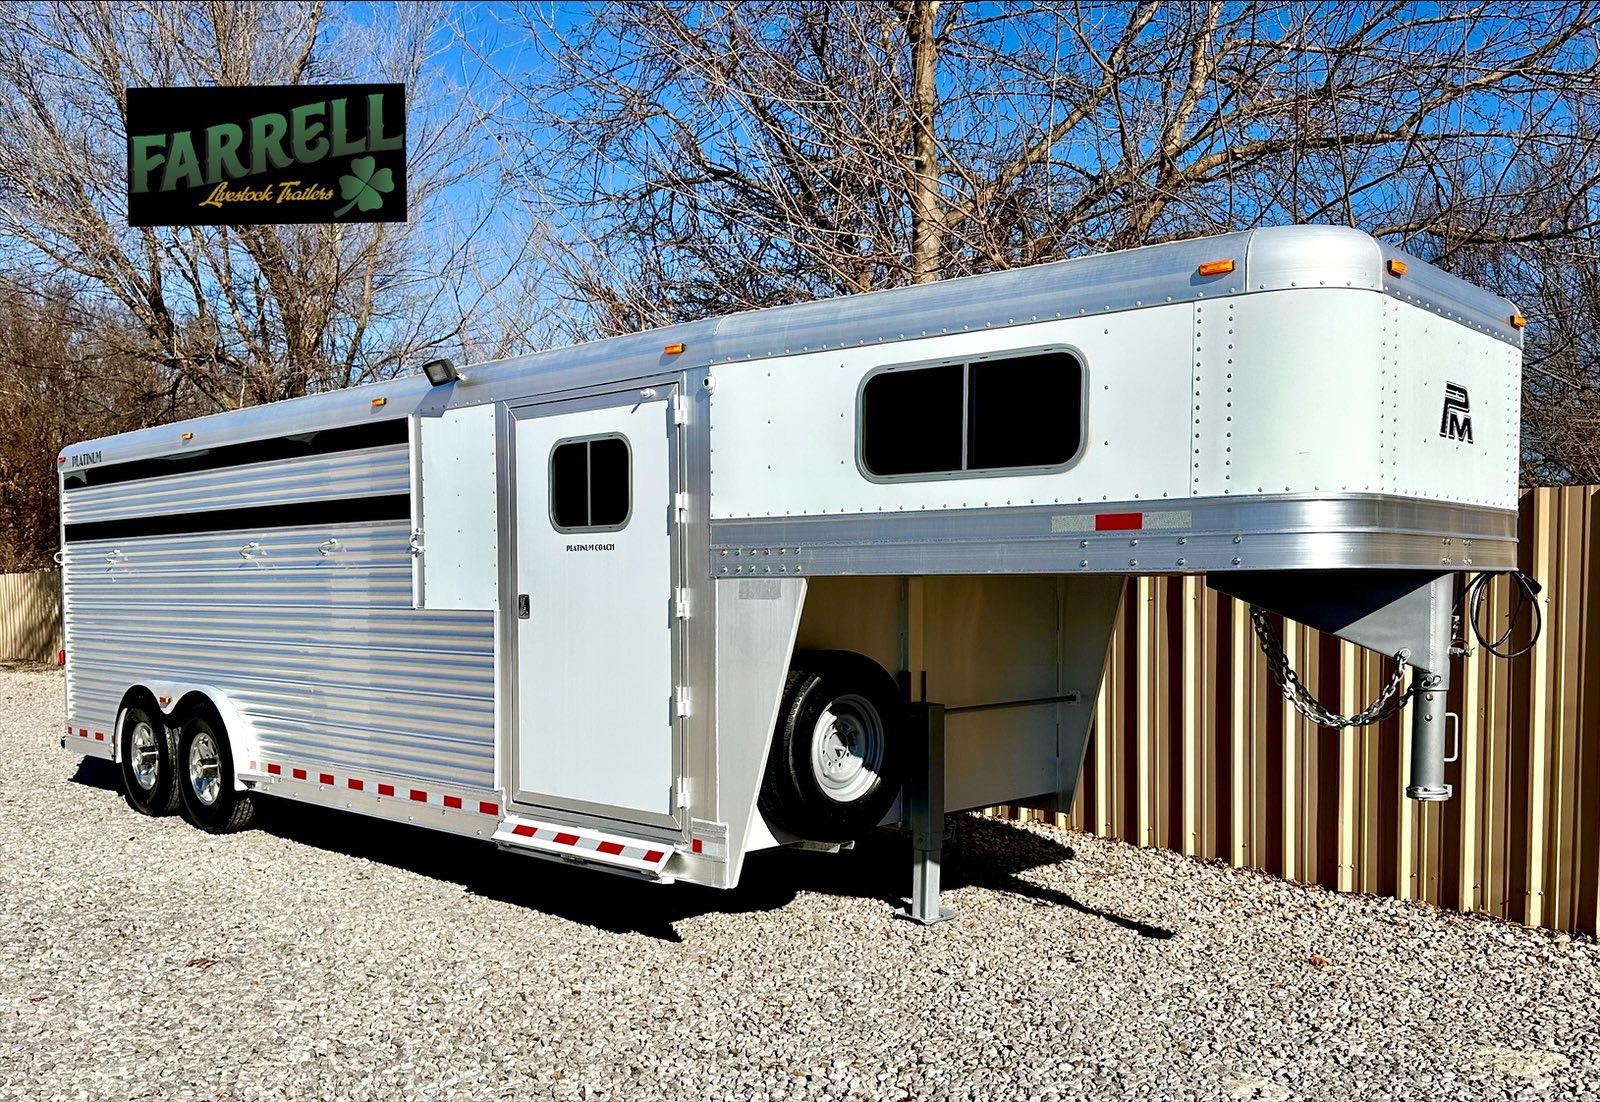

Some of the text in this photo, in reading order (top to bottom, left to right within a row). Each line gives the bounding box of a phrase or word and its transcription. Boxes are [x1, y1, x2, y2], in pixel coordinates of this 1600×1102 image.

[71, 450, 102, 468] PLATINUM
[566, 543, 615, 552] PLATINUM COACH
